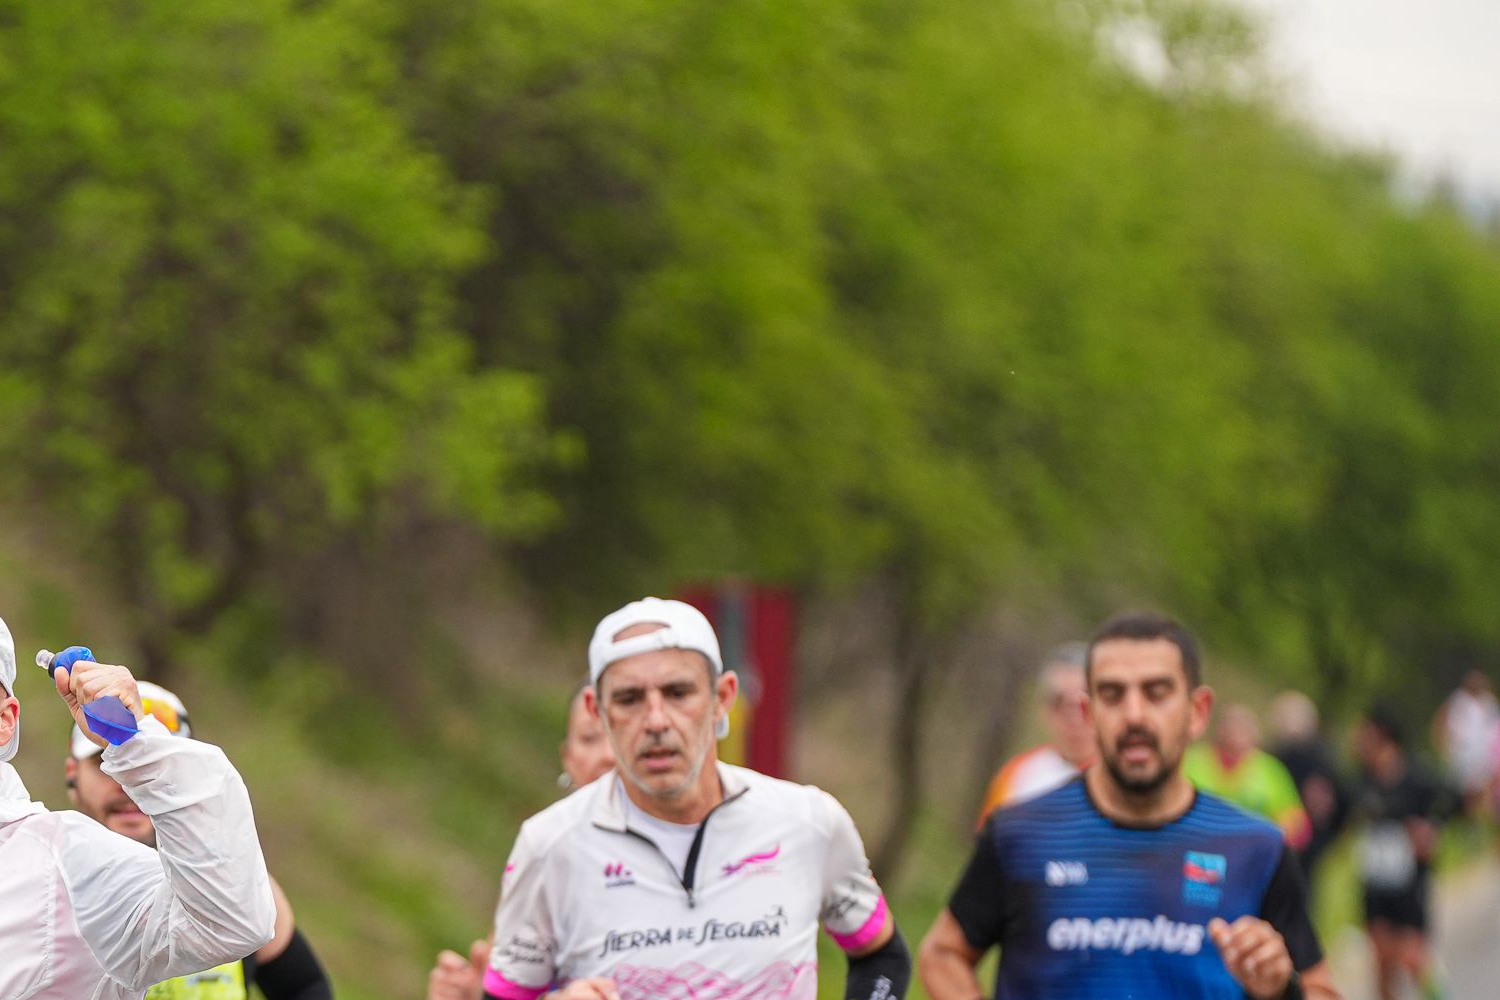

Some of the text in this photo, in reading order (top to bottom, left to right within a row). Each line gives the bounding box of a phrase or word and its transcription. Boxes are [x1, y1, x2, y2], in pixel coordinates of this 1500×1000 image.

[599, 927, 672, 958] SIERRA
[696, 918, 781, 946] SEGURA
[1047, 914, 1205, 956] enerplus
